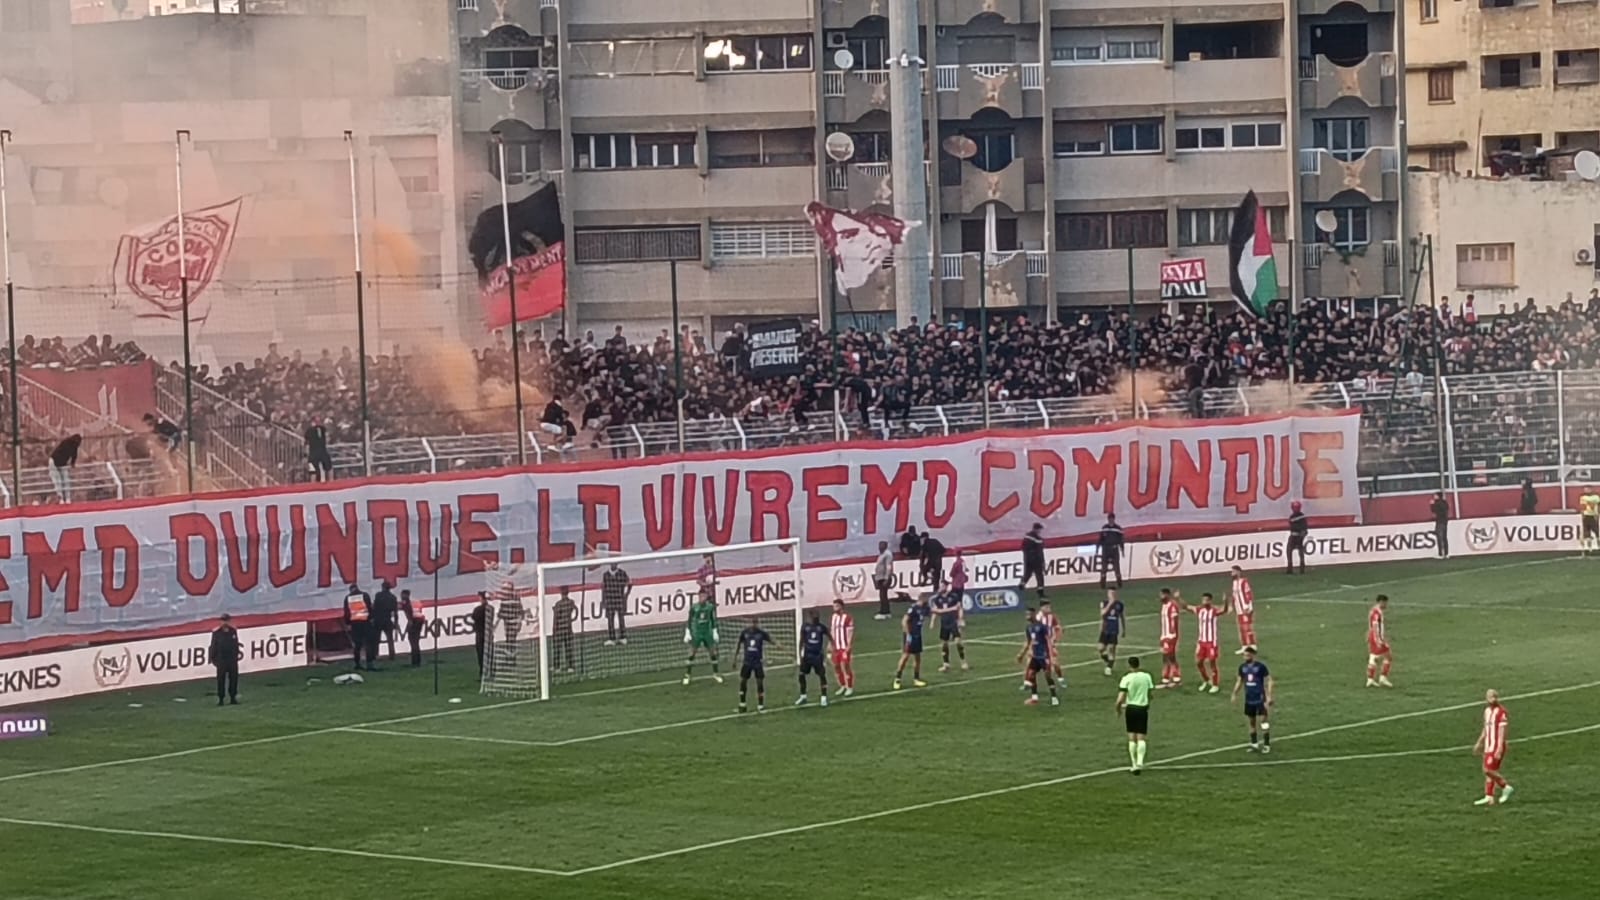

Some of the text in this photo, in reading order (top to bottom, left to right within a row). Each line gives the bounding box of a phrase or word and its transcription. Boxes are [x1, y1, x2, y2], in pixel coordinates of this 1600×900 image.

[641, 460, 958, 552] VIVREMO
[979, 432, 1343, 524] COMUNQUE
[1190, 530, 1437, 565] VOLUBILIS ÔTEL MEKNES
[975, 560, 1024, 583] HÔTE
